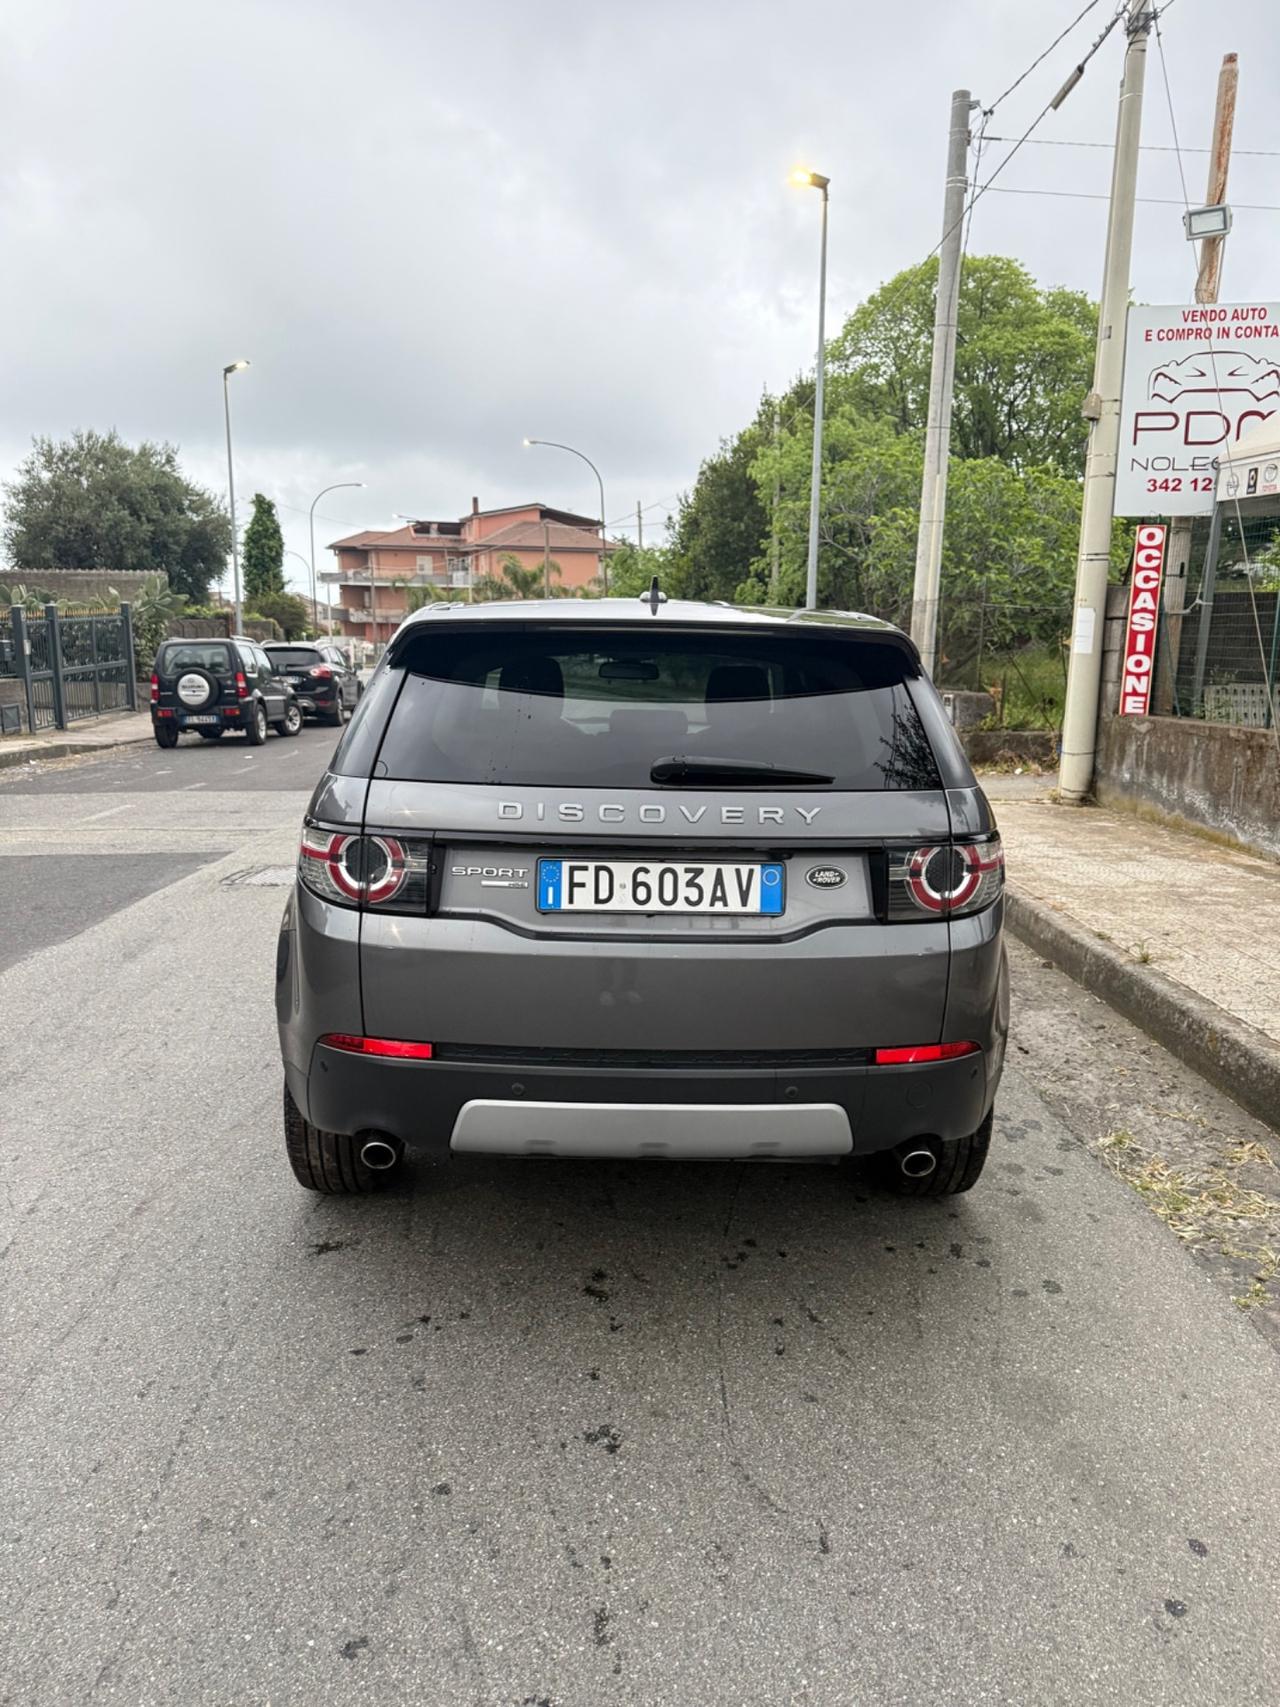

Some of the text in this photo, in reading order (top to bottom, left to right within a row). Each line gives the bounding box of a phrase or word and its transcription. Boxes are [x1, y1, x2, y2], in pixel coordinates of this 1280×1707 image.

[1182, 307, 1268, 323] VENDO AUTO
[1144, 329, 1153, 342] E
[1157, 327, 1213, 342] COMPRO
[1217, 326, 1230, 339] IN
[1146, 476, 1216, 493] 342 12
[1124, 527, 1164, 714] OCCASIONE
[497, 801, 822, 825] DISCOVERY
[451, 866, 529, 878] SPORT
[568, 865, 755, 907] FD 603AV
